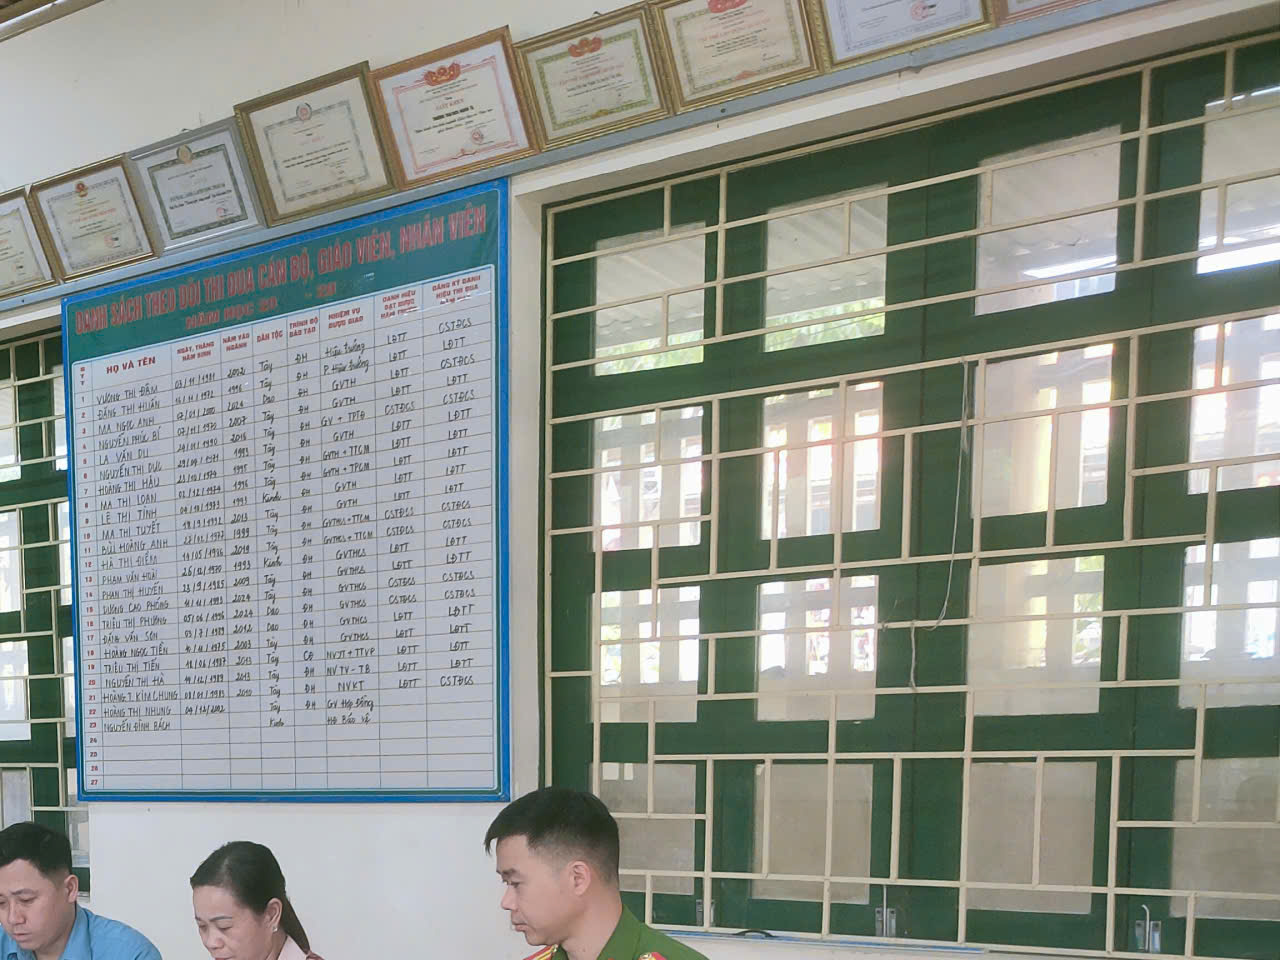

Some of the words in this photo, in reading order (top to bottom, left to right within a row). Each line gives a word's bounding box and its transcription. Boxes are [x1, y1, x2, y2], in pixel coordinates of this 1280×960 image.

[76, 304, 109, 334] DANH
[110, 296, 143, 326] SÁCH
[145, 286, 176, 316] THEO
[204, 275, 225, 303] THI
[257, 257, 286, 289] CÁN
[318, 238, 352, 275] GIÁO
[356, 228, 395, 265] VIÊN,
[399, 214, 445, 254] NHÂN
[448, 202, 487, 240] VIÊN
[348, 316, 364, 324] GIAO
[387, 332, 408, 344] LĐTT
[443, 337, 466, 351] LĐTT
[389, 350, 408, 363] LĐTT
[106, 365, 119, 374] HỌ
[122, 361, 135, 370] VÀ
[137, 356, 156, 367] TÊN
[390, 367, 409, 380] LĐTT
[447, 373, 469, 386] LĐTT
[332, 377, 357, 391] GVTH
[391, 385, 411, 397] LĐTT
[332, 397, 356, 409] GVTH
[448, 408, 473, 422] LĐTT
[98, 425, 111, 435] MA
[392, 419, 412, 432] LĐTT
[333, 430, 354, 442] GVTH
[448, 428, 468, 440] LĐTT
[392, 437, 411, 449] LĐTT
[448, 446, 469, 458] LĐTT
[393, 455, 412, 466] LĐTT
[446, 464, 467, 476] LĐTT
[394, 472, 413, 484] LĐTT
[335, 481, 357, 493] GVTH
[444, 483, 465, 494] LĐTT
[100, 500, 112, 510] MA
[137, 493, 157, 505] LOAN
[394, 491, 411, 501] LĐTT
[337, 498, 358, 509] GVTH
[102, 530, 115, 540] MA
[233, 528, 250, 538] 1999
[151, 539, 168, 548] ANH
[445, 535, 468, 547] LĐTT
[389, 542, 410, 554] LĐTT
[446, 551, 472, 565] LĐTT
[392, 559, 413, 571] LĐTT
[393, 611, 414, 622] LĐTT
[448, 604, 475, 617] LĐTT
[396, 628, 415, 639] LĐTT
[450, 623, 472, 634] LĐTT
[397, 645, 420, 655] LĐTT
[450, 641, 471, 652] LĐTT
[398, 661, 420, 673] LĐTT
[450, 658, 474, 669] LĐTT
[399, 678, 421, 690] LĐTT
[145, 706, 171, 716] NHUNG
